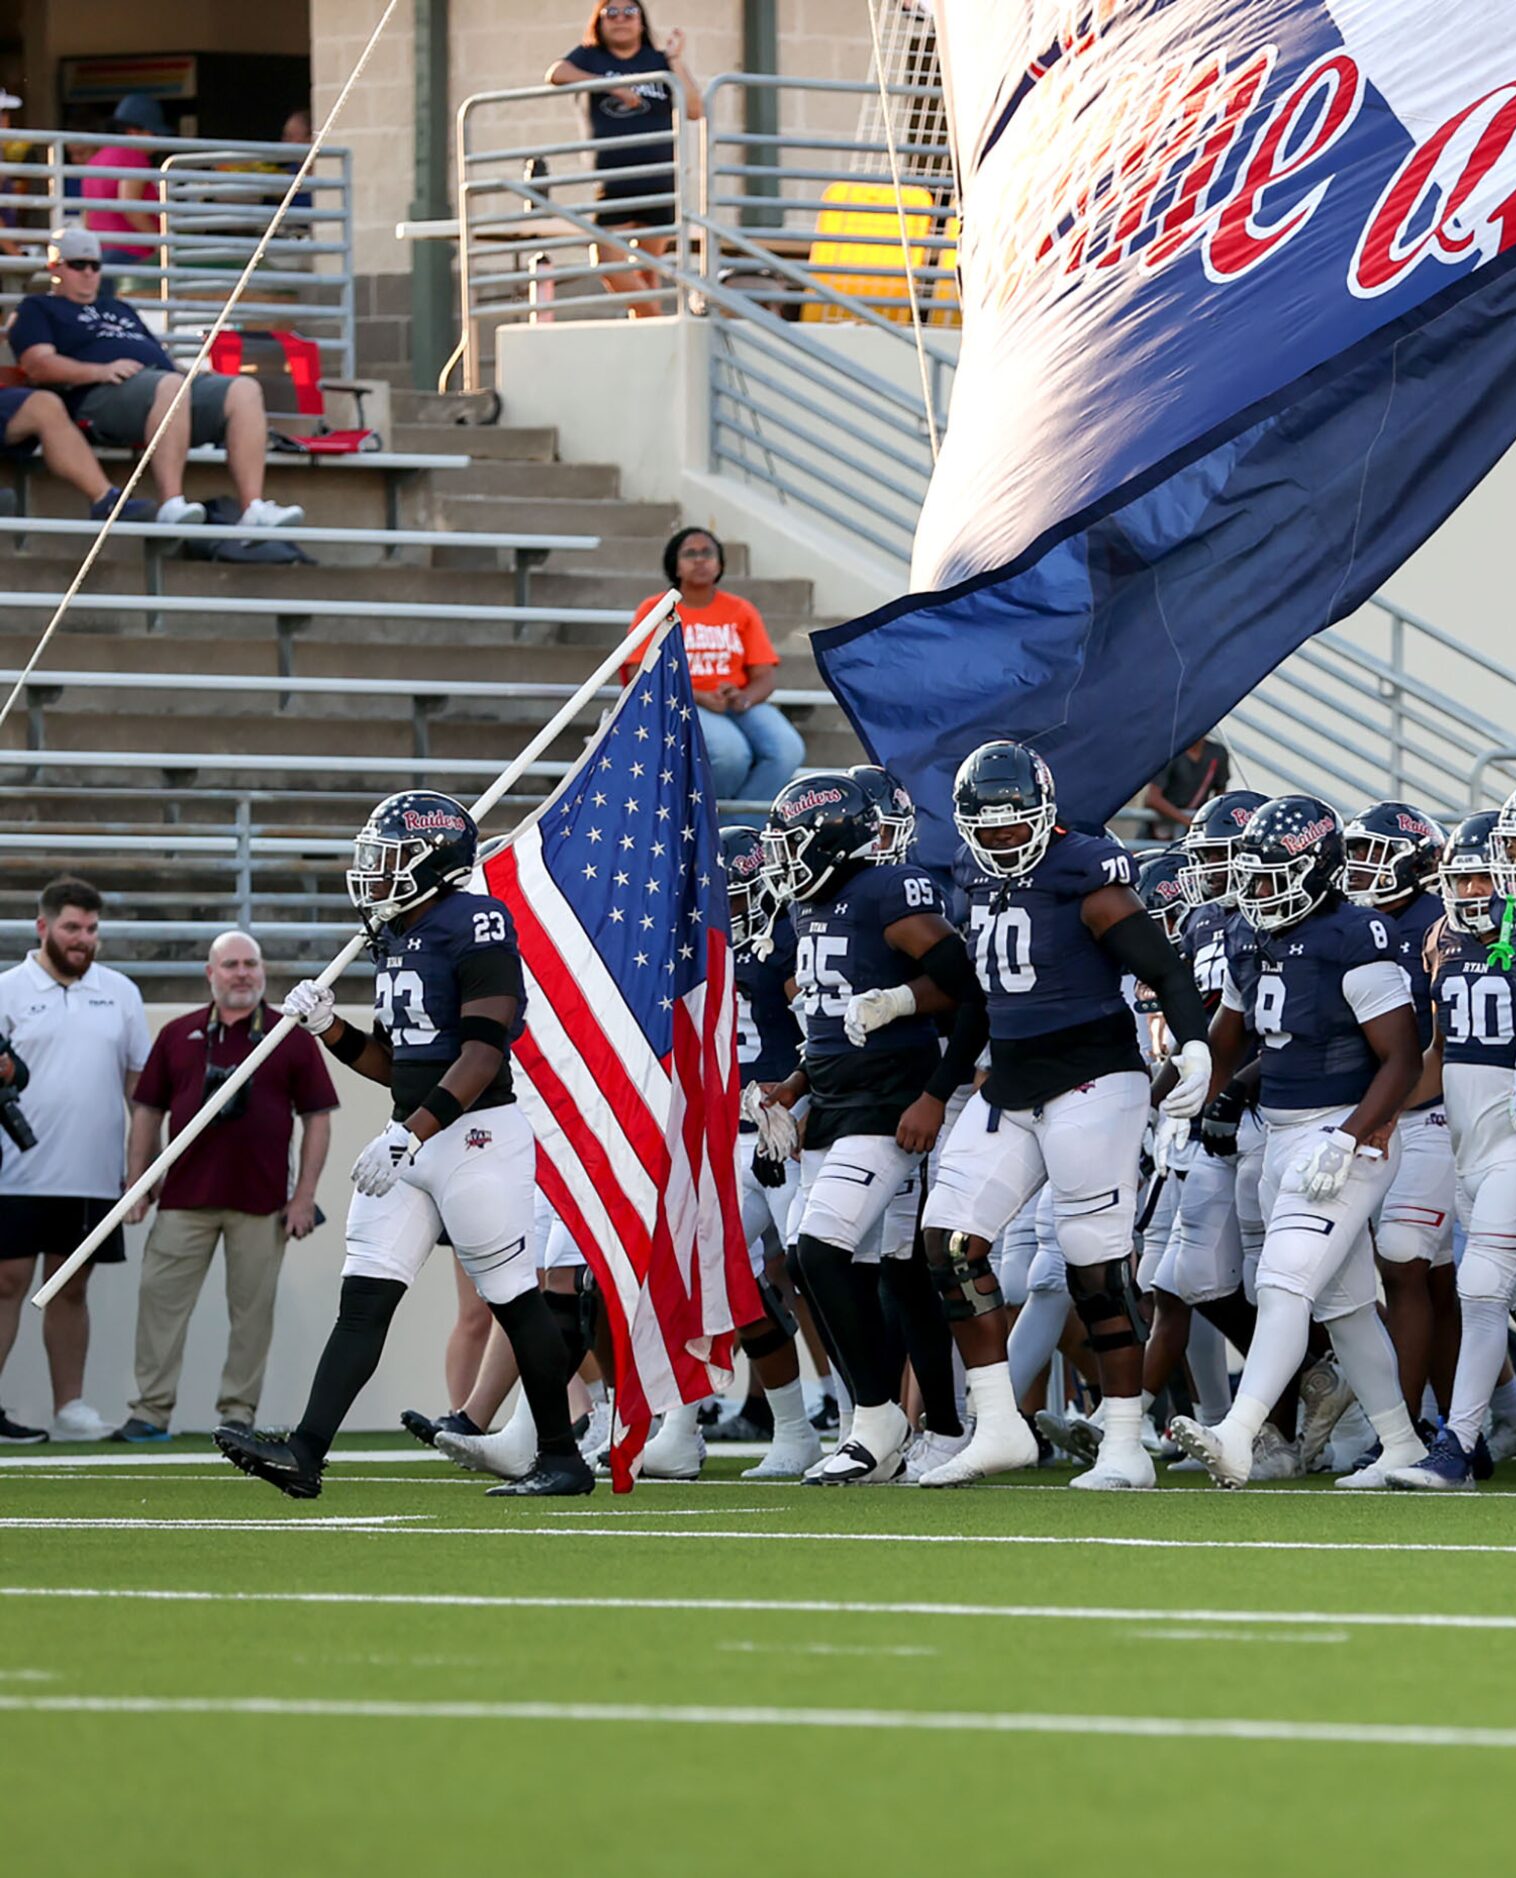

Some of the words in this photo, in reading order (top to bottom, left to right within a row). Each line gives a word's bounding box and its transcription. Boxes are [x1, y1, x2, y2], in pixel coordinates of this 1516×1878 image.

[780, 788, 842, 822] Raiders
[402, 811, 466, 831] Raiders
[1102, 855, 1130, 884] 70
[904, 878, 934, 907] 85
[472, 911, 505, 942] 23
[1369, 920, 1388, 948] 8
[971, 905, 1037, 993] 70
[1462, 962, 1490, 974] RYAN
[1255, 975, 1293, 1049] 8
[1441, 975, 1515, 1045] 30
